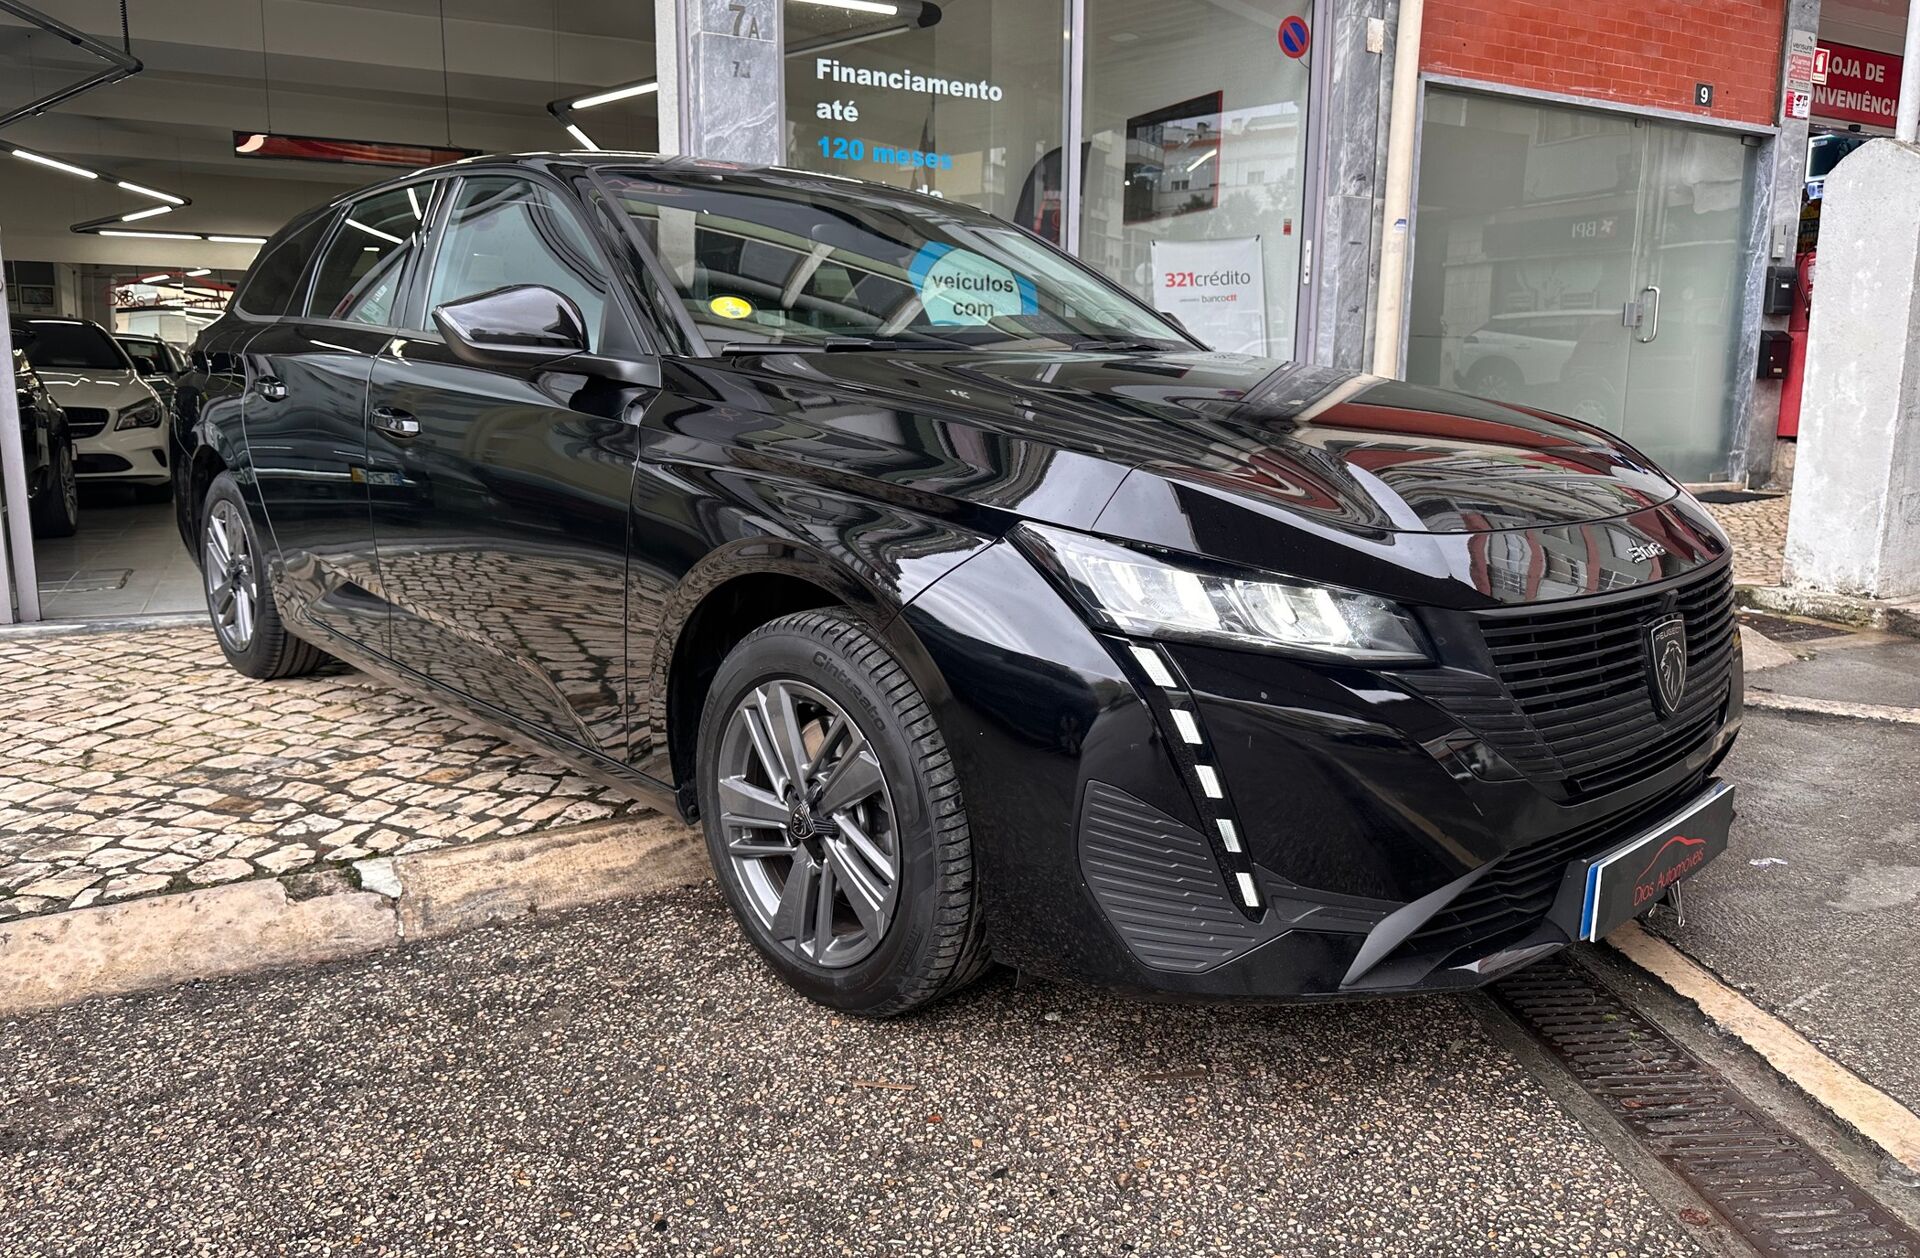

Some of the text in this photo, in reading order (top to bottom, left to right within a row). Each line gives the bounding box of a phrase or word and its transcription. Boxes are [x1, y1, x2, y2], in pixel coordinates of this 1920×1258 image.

[728, 3, 760, 40] 7A
[816, 58, 1003, 102] Financiamento
[1865, 63, 1885, 83] DE
[1700, 87, 1709, 104] 9
[1811, 83, 1898, 117] NVENIÊNCI
[816, 100, 859, 122] até
[818, 136, 953, 170] 120 meses
[932, 272, 1014, 293] veículos
[953, 302, 994, 317] com
[813, 651, 886, 732] Cinturato
